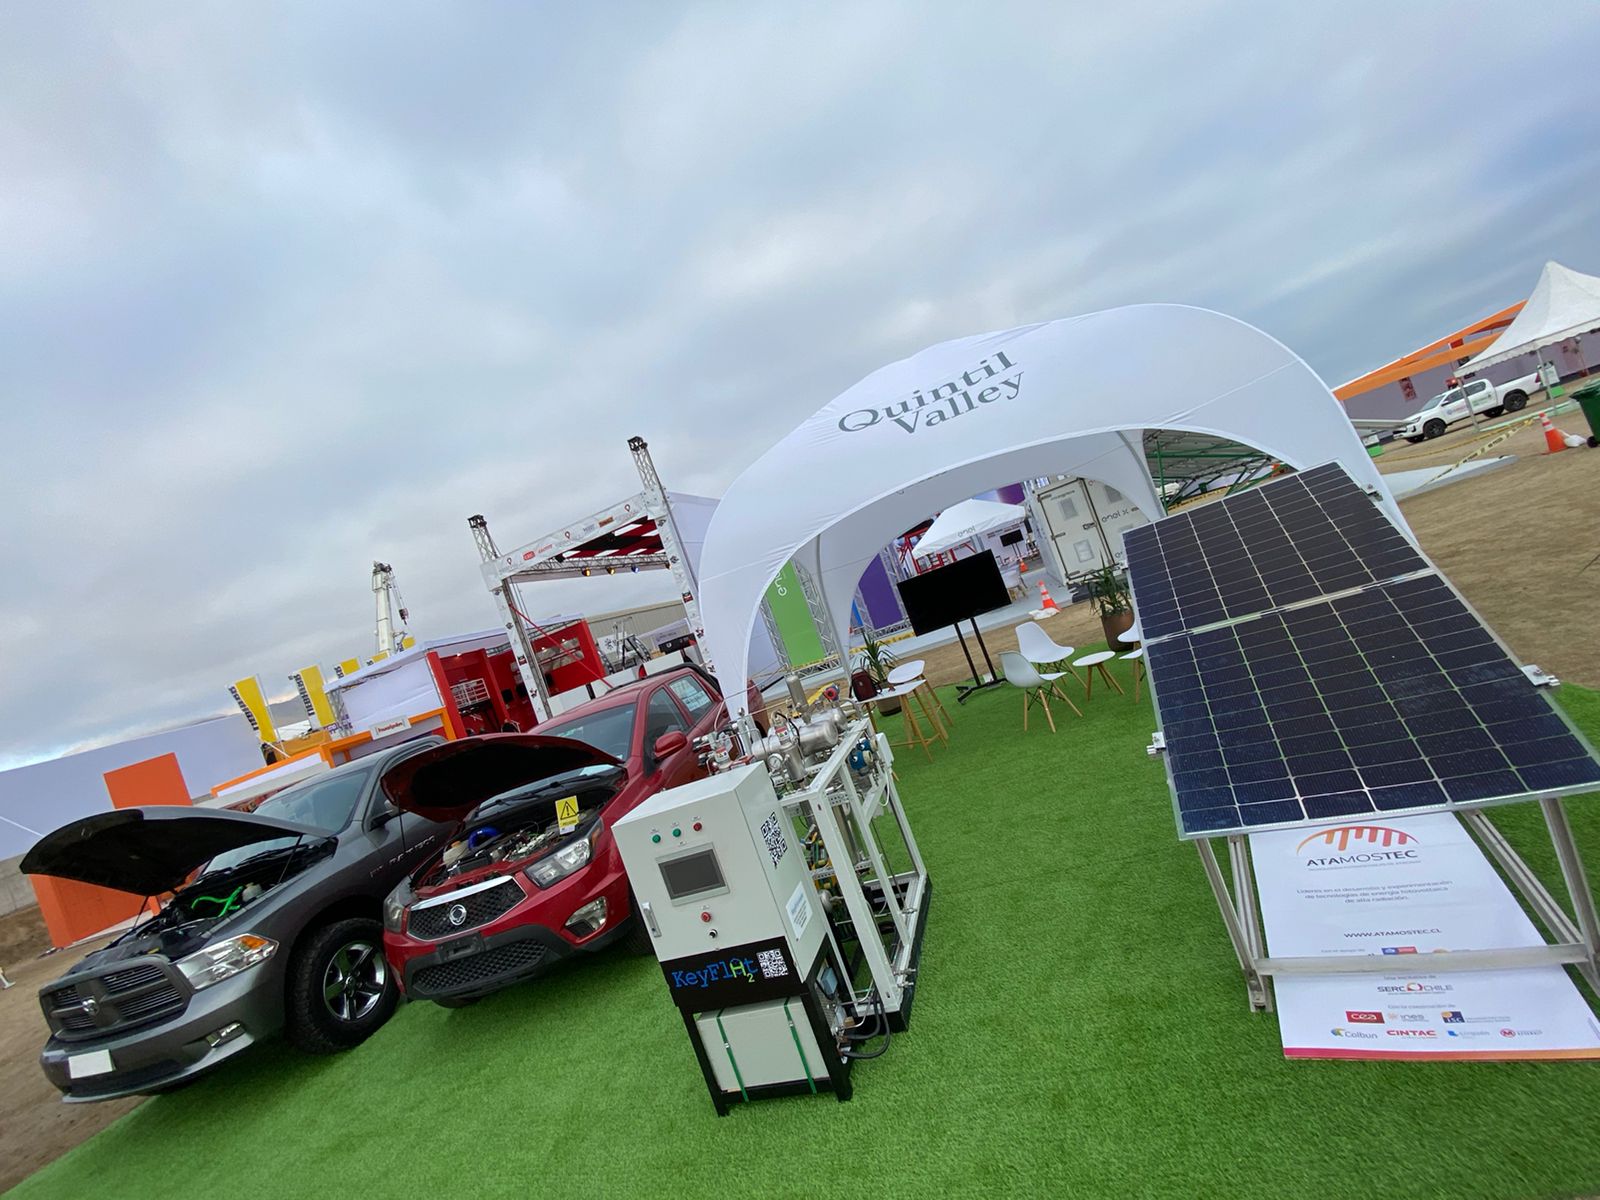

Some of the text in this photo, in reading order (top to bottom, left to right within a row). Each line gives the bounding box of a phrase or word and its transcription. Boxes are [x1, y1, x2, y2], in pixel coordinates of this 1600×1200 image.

[838, 351, 1017, 432] Quintil
[891, 371, 1024, 434] Valley
[1307, 849, 1419, 867] ATAMOSTEC
[1377, 985, 1406, 993] SERC
[1423, 984, 1454, 992] CHILE
[1345, 1031, 1378, 1039] Colbun
